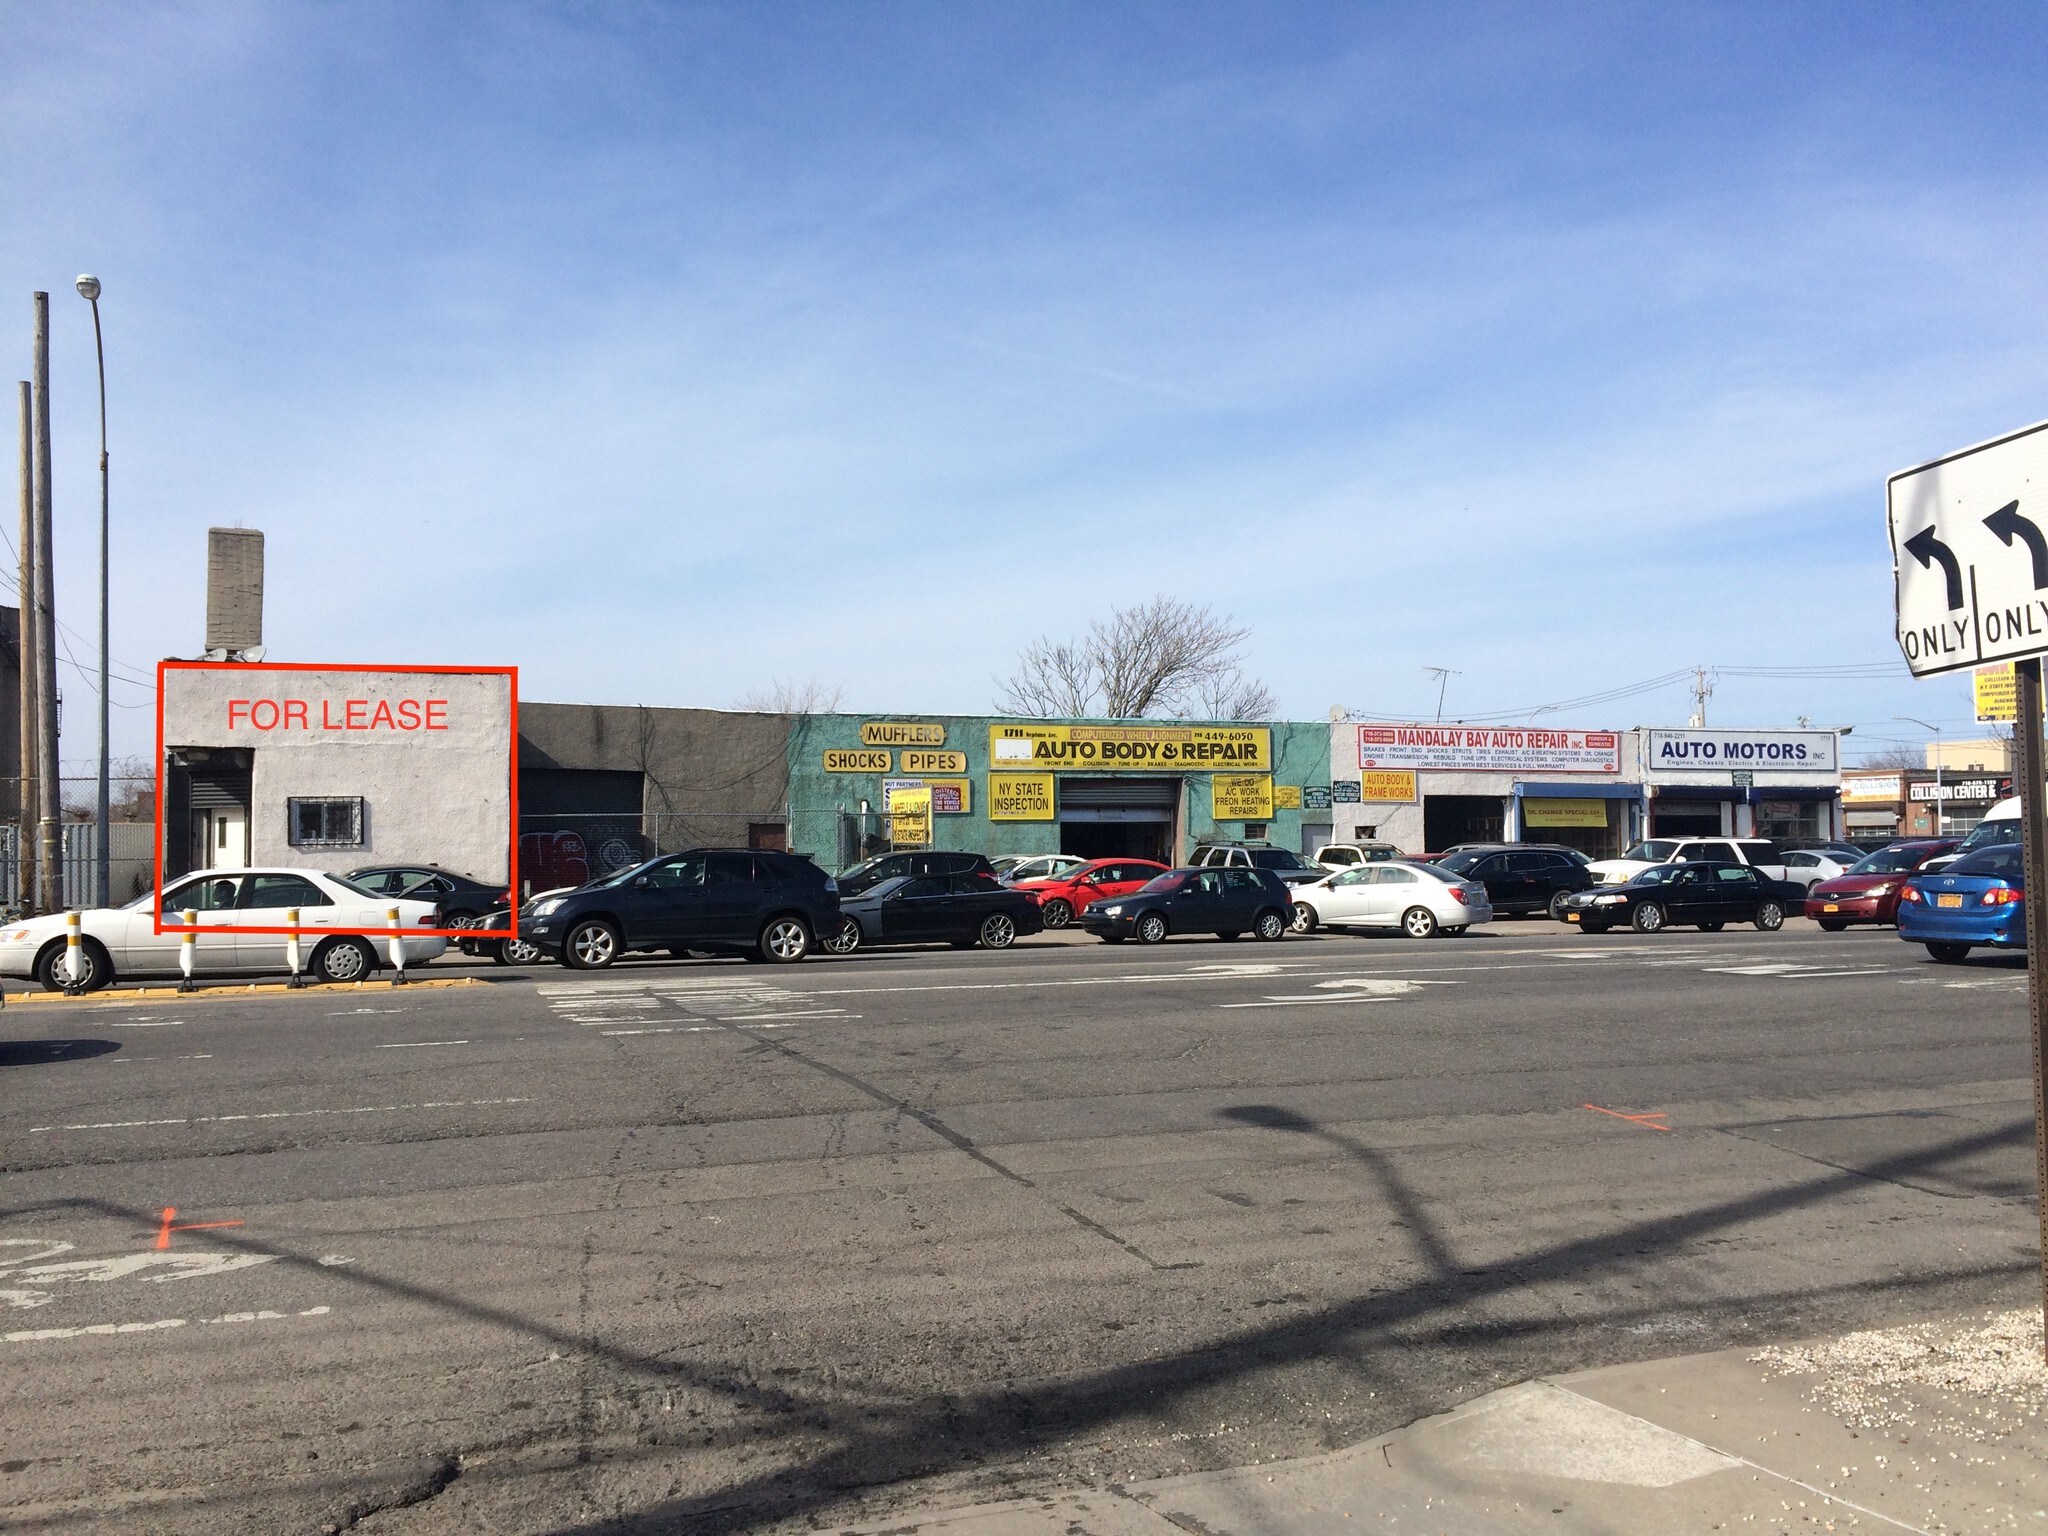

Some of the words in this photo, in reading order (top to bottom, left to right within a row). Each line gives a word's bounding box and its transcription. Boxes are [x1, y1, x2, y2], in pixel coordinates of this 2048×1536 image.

[1905, 619, 1968, 660] ONLY
[868, 726, 942, 742] MUFFLERS
[1004, 729, 1023, 738] 1711
[1072, 730, 1124, 740] COMPUTERIZED
[1126, 730, 1150, 740] WHEEL
[1152, 731, 1190, 740] ALIGNMENT
[1204, 732, 1253, 740] 449-6050
[1398, 730, 1462, 746] MANDALAY
[1467, 732, 1490, 747] BAY
[1492, 732, 1523, 748] AUTO
[1528, 733, 1568, 748] REPAIR
[1572, 741, 1584, 749] INC.
[1034, 742, 1096, 758] AUTO
[1102, 742, 1160, 759] BODY
[1162, 743, 1178, 759] &
[1182, 743, 1258, 760] REPAIR
[1660, 742, 1716, 758] AUTO
[1724, 742, 1806, 760] MOTORS
[828, 754, 886, 768] SHOCKS
[910, 754, 956, 768] PIPES
[1231, 778, 1242, 786] WE
[1245, 778, 1254, 786] DO
[1366, 774, 1385, 785] AUTO
[1386, 774, 1405, 785] BODY
[1407, 775, 1410, 785] &
[999, 783, 1012, 795] NY
[1016, 783, 1043, 795] STATE
[1225, 788, 1236, 796] A/C
[1240, 788, 1260, 796] WORK
[1854, 782, 1898, 790] COLLISION
[1910, 786, 1953, 800] COLLISON
[1954, 785, 1988, 798] CENTER
[1988, 784, 1996, 798] &
[1365, 787, 1388, 798] FRAME
[1390, 787, 1413, 798] WORKS
[994, 798, 1048, 810] INSPECTION
